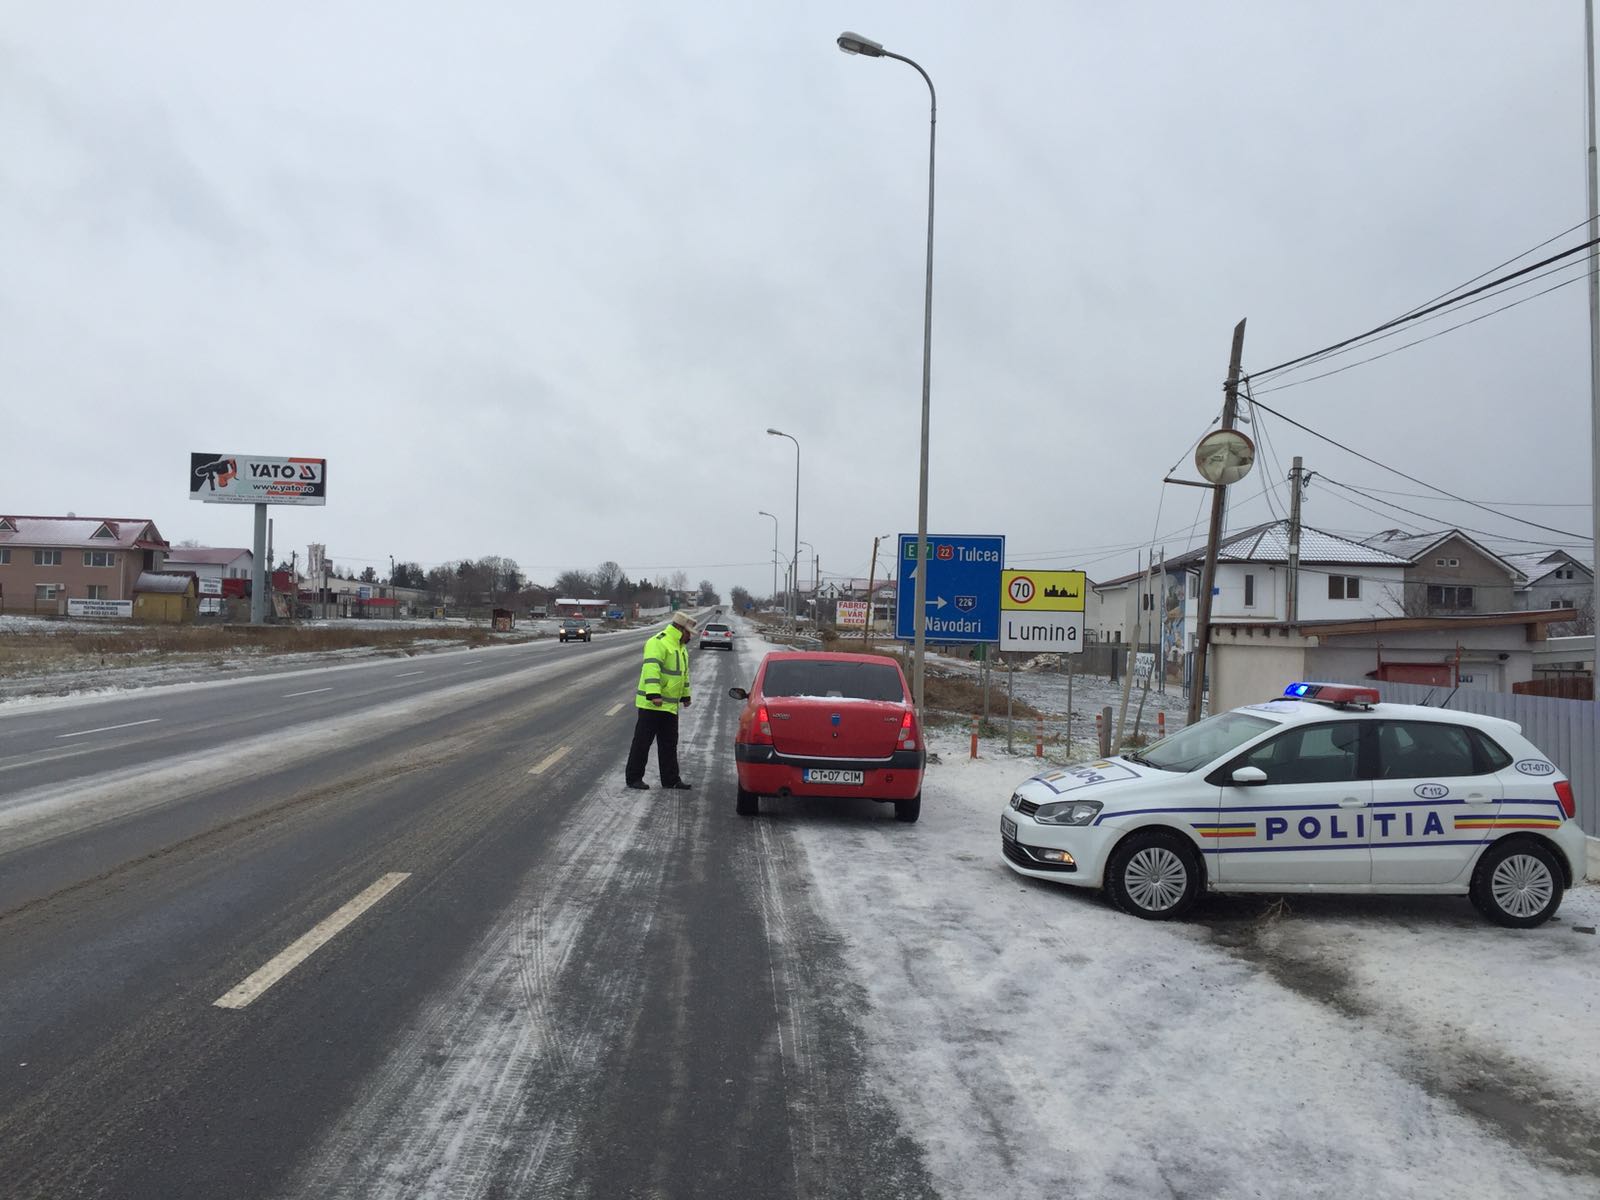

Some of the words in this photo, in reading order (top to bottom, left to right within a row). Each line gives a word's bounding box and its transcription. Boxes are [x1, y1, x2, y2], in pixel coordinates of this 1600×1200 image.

[250, 463, 295, 478] YATO
[252, 483, 315, 493] www.yato.ro
[940, 549, 950, 557] 22
[957, 546, 999, 562] Tulcea
[1014, 583, 1030, 598] 70
[838, 601, 872, 609] FABRIC
[958, 598, 973, 607] 226
[925, 616, 981, 633] Năvodari
[1008, 621, 1077, 641] Lumina
[1521, 763, 1550, 772] CT-070
[843, 771, 861, 782] CIM
[1430, 787, 1442, 795] 112
[1265, 811, 1445, 841] POLITIA
